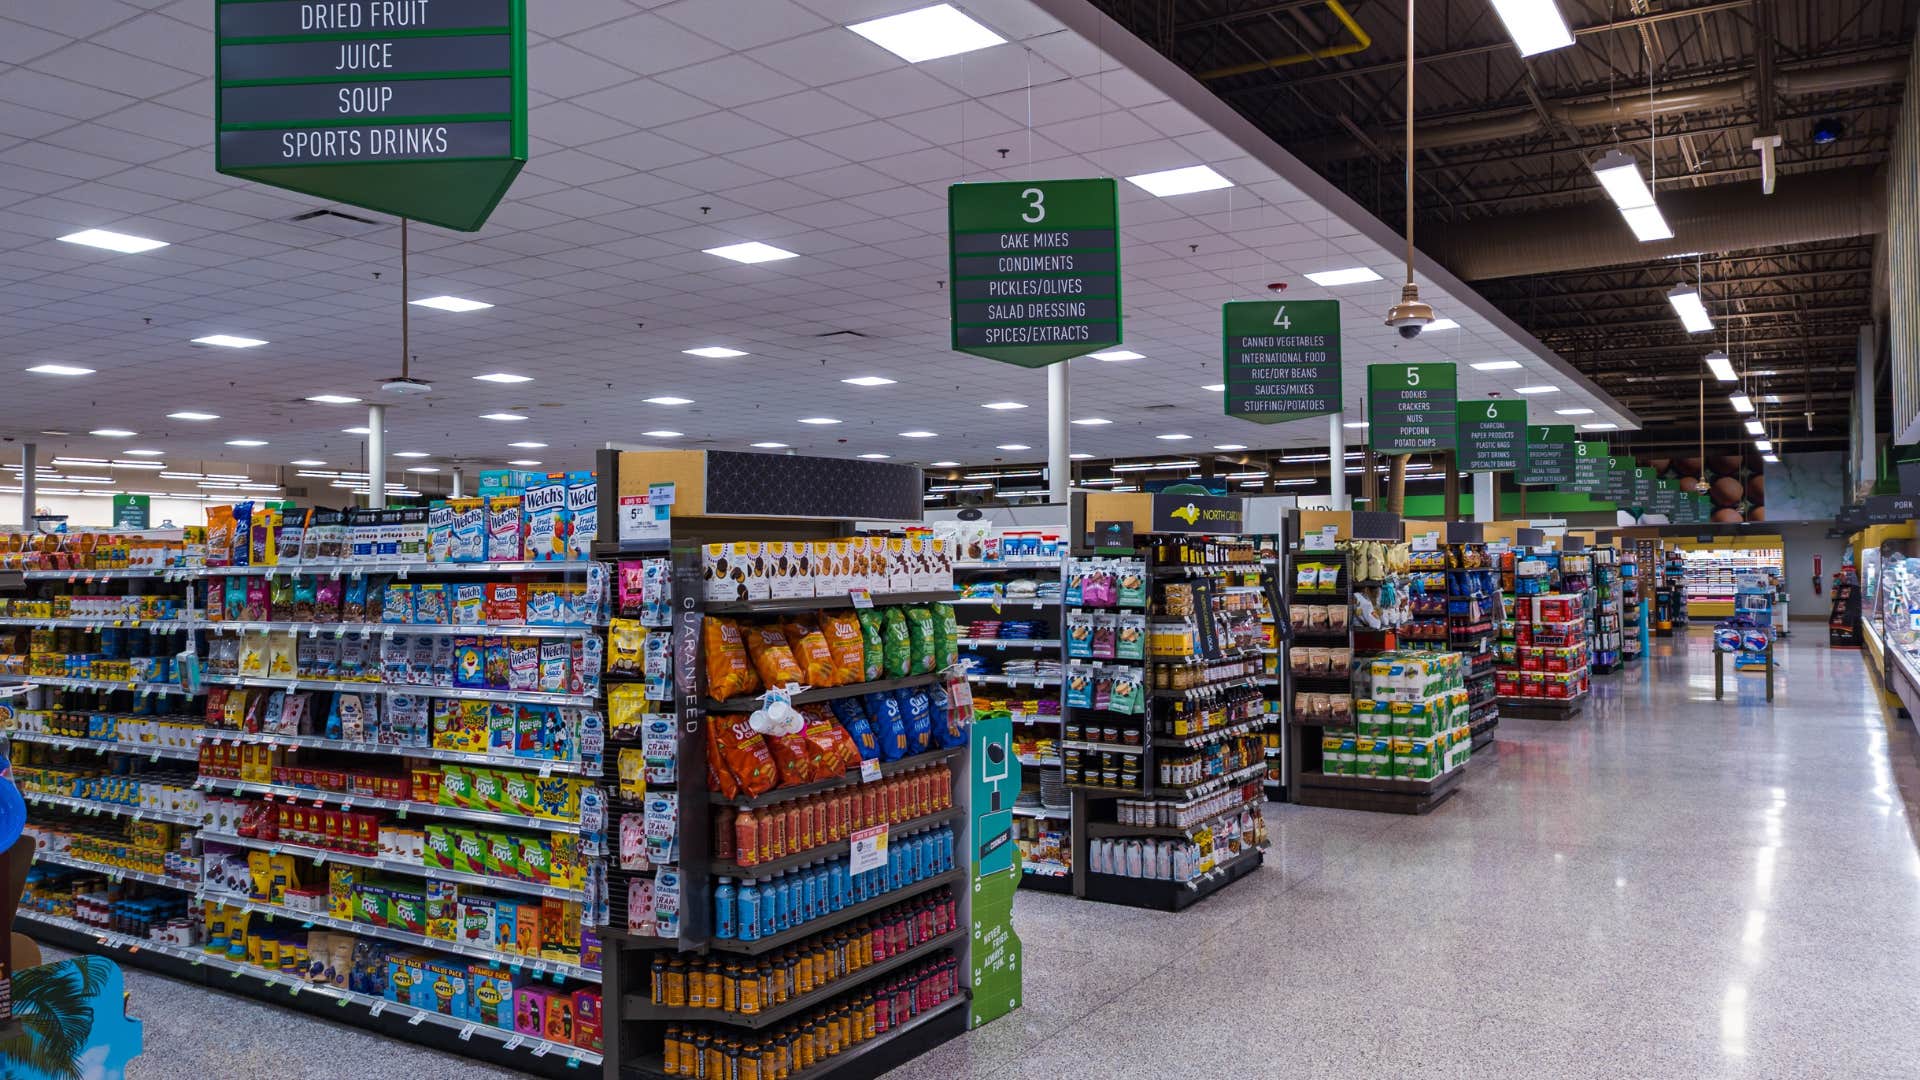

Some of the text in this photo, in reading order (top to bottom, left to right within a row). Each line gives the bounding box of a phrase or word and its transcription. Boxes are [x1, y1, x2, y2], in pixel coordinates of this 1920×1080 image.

[301, 0, 428, 30] DRIED FRUIT
[336, 43, 393, 70] JUICE
[339, 86, 393, 113] SOUP
[282, 127, 448, 158] SPORTS DRINKS
[1021, 188, 1046, 224] 3
[1000, 232, 1069, 249] CAKE MIXES
[999, 255, 1073, 272] CONDIMENTS
[989, 278, 1082, 296] PICKLES/OLIVES
[988, 302, 1086, 320] SALAD DRESSING
[1273, 305, 1291, 329] 4
[986, 325, 1089, 343] SPICES/EXTRACTS
[1242, 335, 1324, 347] CANNED VEGETABLES
[1242, 352, 1326, 363] INTERNATIONAL FOOD
[1251, 368, 1317, 379] RICE/DRY BEANS
[1407, 367, 1420, 386] 5
[1255, 384, 1314, 395] SAUCES/MIXES
[1401, 390, 1427, 399] COOKIES
[1244, 400, 1325, 412] STUFFING/POTATOES
[1398, 402, 1430, 411] CRACKERS
[1486, 402, 1498, 418] 6
[1406, 414, 1423, 422] NUTS
[1400, 426, 1430, 435] POPCORN
[1541, 427, 1550, 440] 7
[1394, 438, 1437, 447] POTATO CHIPS
[1476, 441, 1496, 449] PLASTIC
[1578, 444, 1587, 456] 8
[1609, 459, 1616, 469] 9
[1658, 481, 1666, 489] 11
[527, 488, 563, 508] Welch's
[570, 487, 597, 506] Welc
[1894, 501, 1914, 509] PORK
[430, 510, 451, 525] Welch
[454, 511, 482, 529] Welch's
[491, 510, 517, 529] Welch's
[536, 517, 551, 526] Fruit
[580, 515, 594, 526] Fruit
[1203, 510, 1225, 520] NORTH
[533, 524, 553, 533] Snacks
[576, 523, 597, 533] Snacks
[460, 588, 480, 598] Welch's
[497, 589, 516, 598] Welch's
[721, 625, 737, 641] Sun
[761, 631, 785, 644] Sun
[835, 622, 854, 637] Sun
[512, 650, 536, 664] Welch's
[683, 597, 697, 733] GUARANTEED
[886, 699, 898, 716] Su
[910, 692, 928, 715] Sun
[732, 721, 749, 740] Su
[445, 775, 465, 791] Foot
[477, 778, 496, 795] Foot
[507, 782, 528, 798] Foot
[430, 835, 448, 851] Foot
[461, 840, 480, 856] Foot
[493, 845, 512, 861] Foot
[524, 849, 545, 866] Foot
[362, 898, 379, 914] Foot
[397, 905, 416, 921] Foot
[974, 921, 981, 939] 20
[391, 957, 421, 968] VALUE PACK
[431, 966, 462, 977] VALUE PACK
[474, 968, 511, 980] FAMILY PACK
